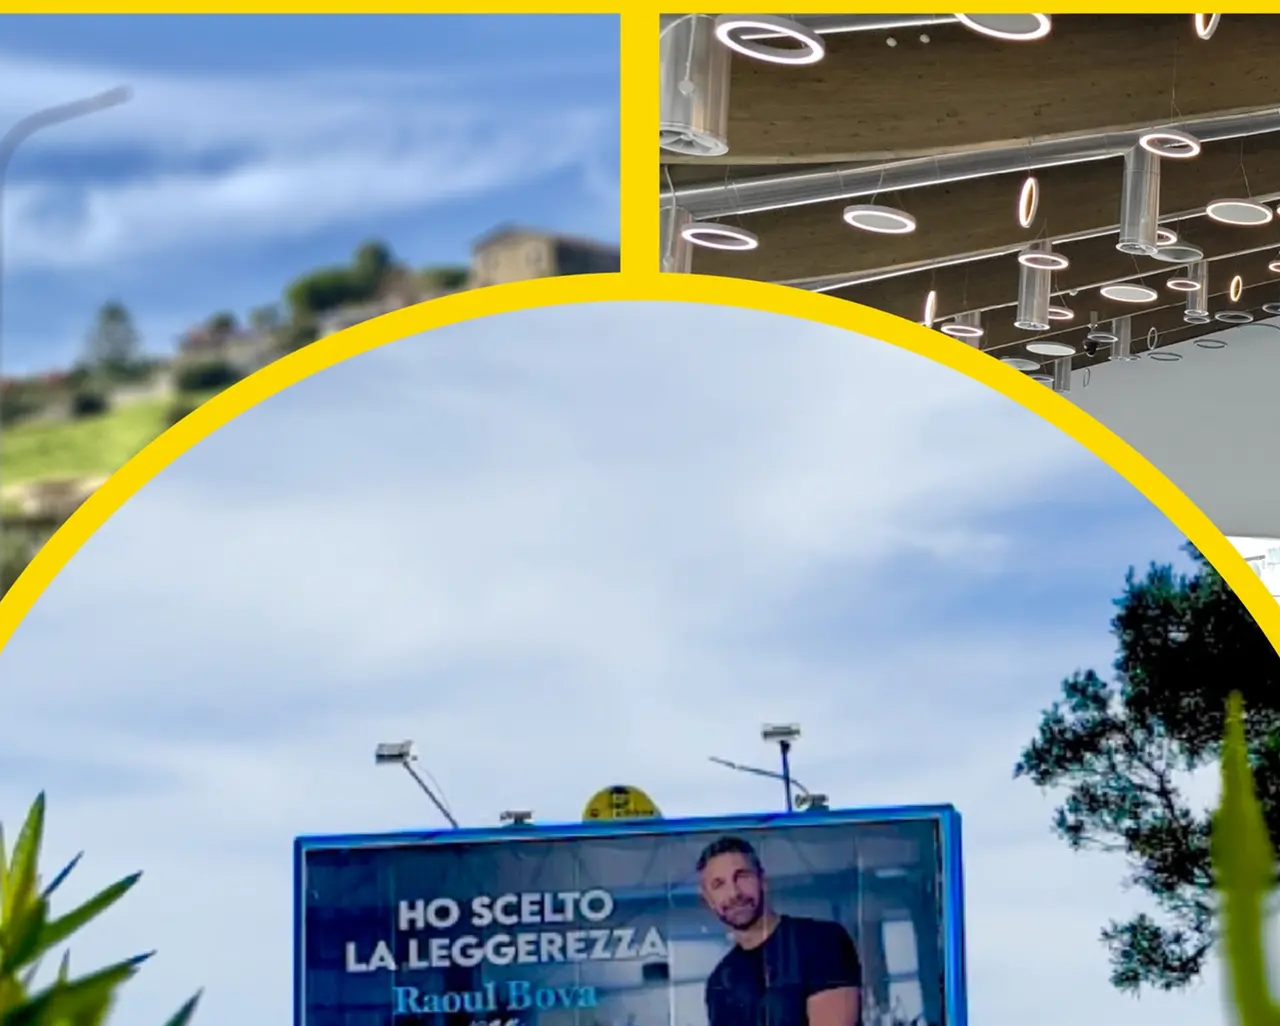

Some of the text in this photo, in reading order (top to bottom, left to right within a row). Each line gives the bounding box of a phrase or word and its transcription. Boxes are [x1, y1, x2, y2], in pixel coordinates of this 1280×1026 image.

[398, 889, 614, 931] HO SCELTO
[345, 926, 669, 973] LA LEGGEREZZA
[393, 978, 598, 1014] Raoul Bova
